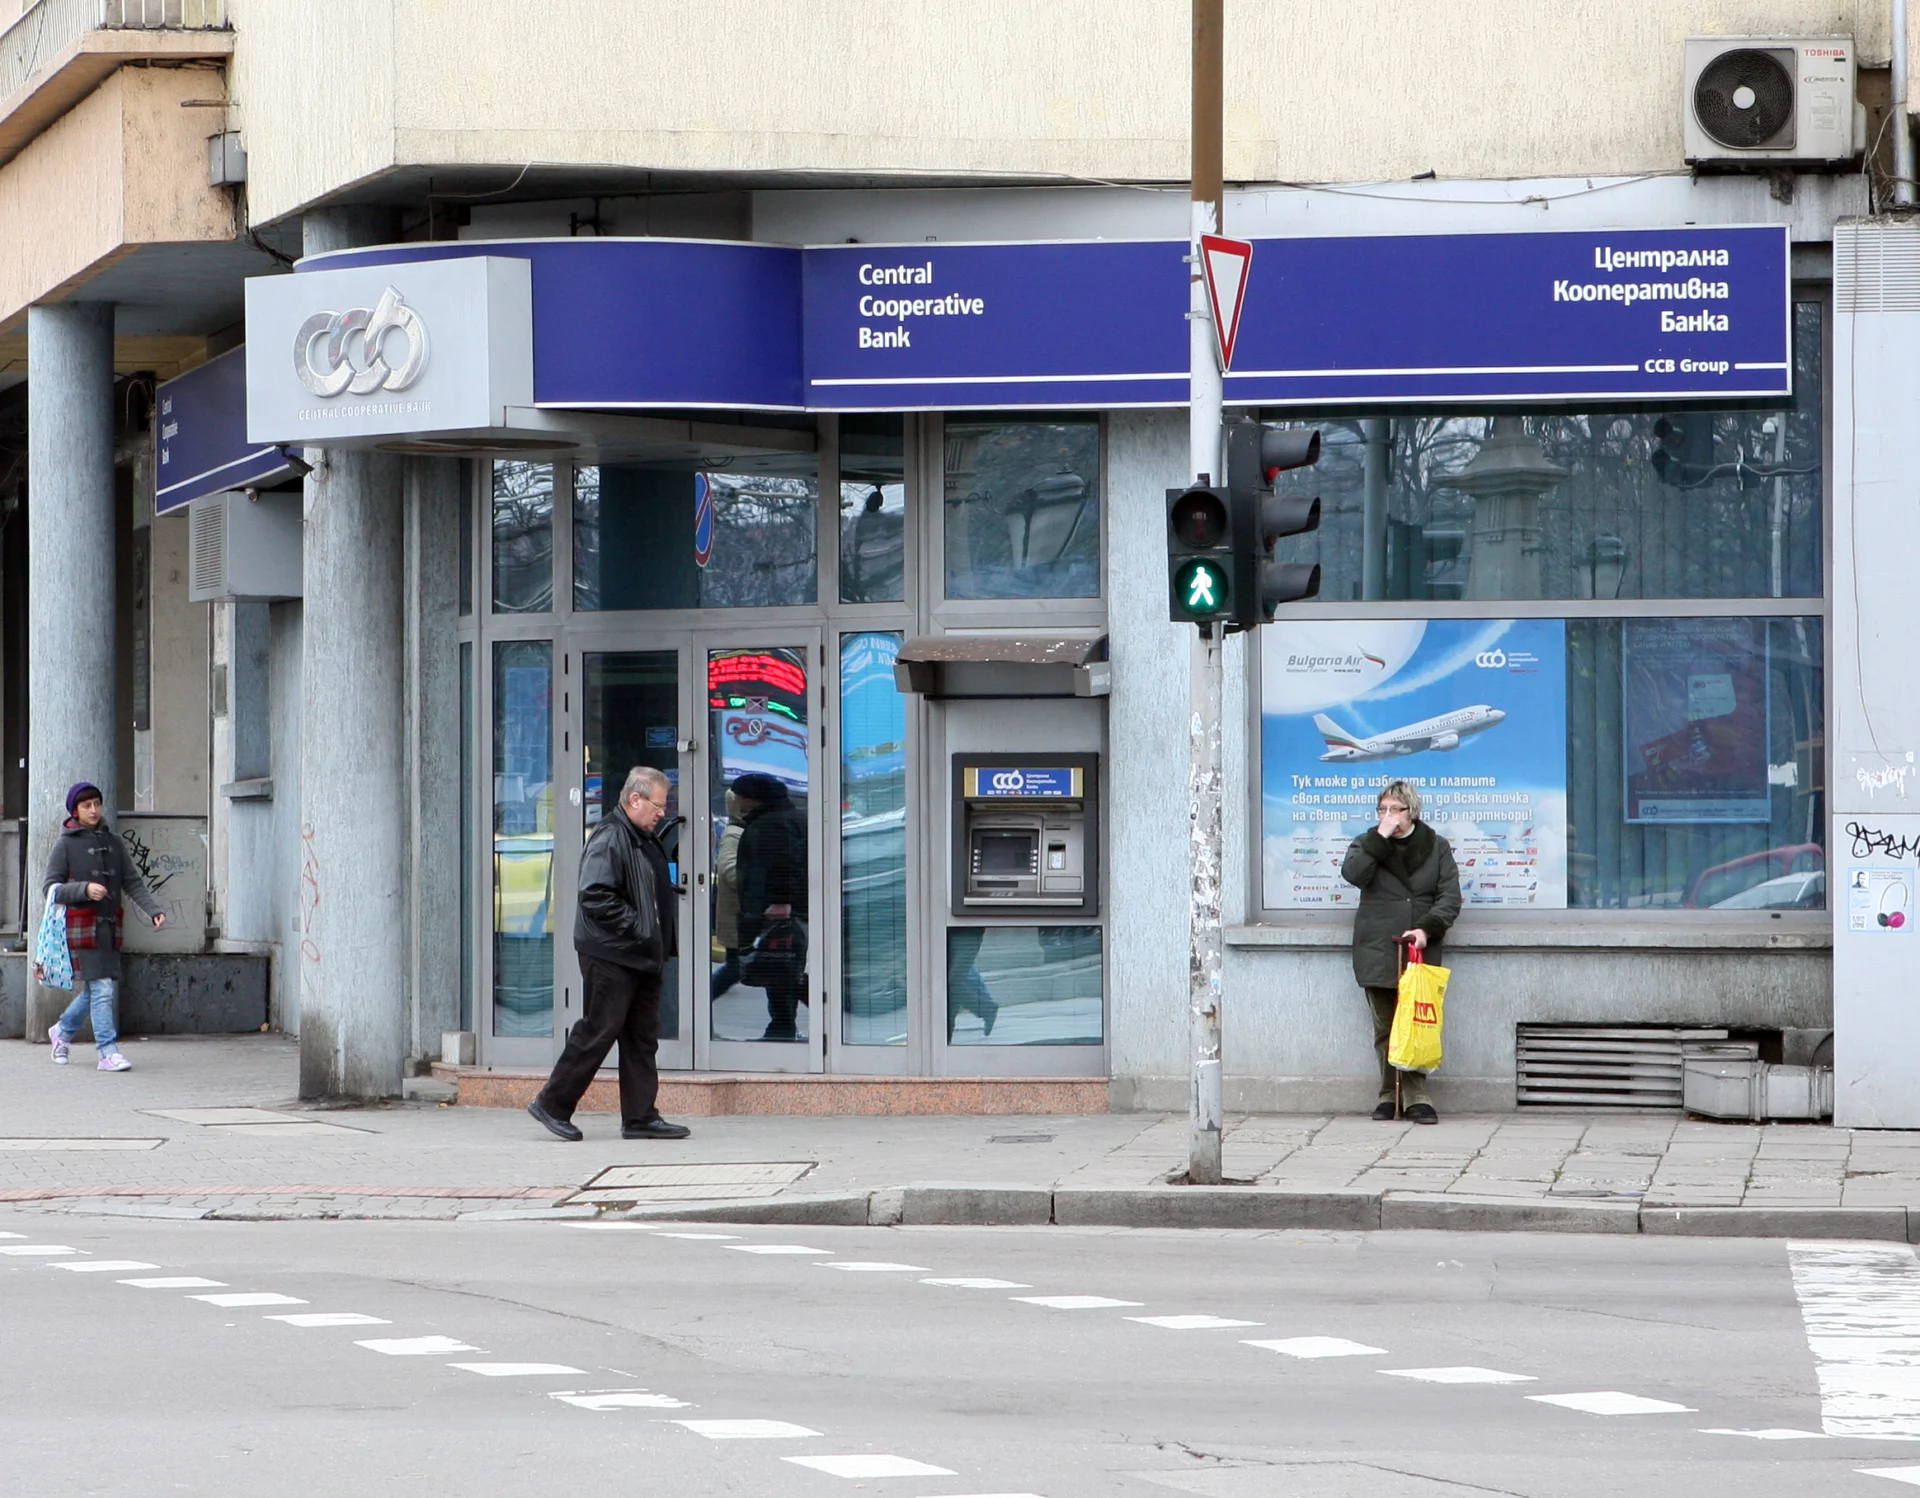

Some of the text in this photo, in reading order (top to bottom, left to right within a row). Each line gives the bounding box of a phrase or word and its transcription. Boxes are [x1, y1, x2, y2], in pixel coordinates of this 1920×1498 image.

[1594, 246, 1729, 272] Централна
[858, 261, 932, 286] Central
[1554, 278, 1729, 306] Кооперативна
[858, 292, 984, 321] Cooperative
[1660, 309, 1729, 332] Банка
[858, 326, 911, 349] Bank
[1644, 358, 1730, 375] CCB Group
[298, 400, 431, 420] CENTRAL COOPERATIVE BANK
[1287, 655, 1363, 668] Bulgaria Air
[1292, 774, 1312, 790] Тук
[1314, 775, 1348, 787] може
[1351, 778, 1365, 790] да
[1440, 776, 1496, 786] платите
[1292, 792, 1320, 804] своя
[1436, 794, 1450, 806] до
[1454, 792, 1488, 804] всяка
[1492, 792, 1529, 804] точка
[1292, 812, 1306, 821] на
[1310, 809, 1348, 821] света
[1434, 809, 1448, 824] Ер
[1462, 809, 1532, 823] партньори!
